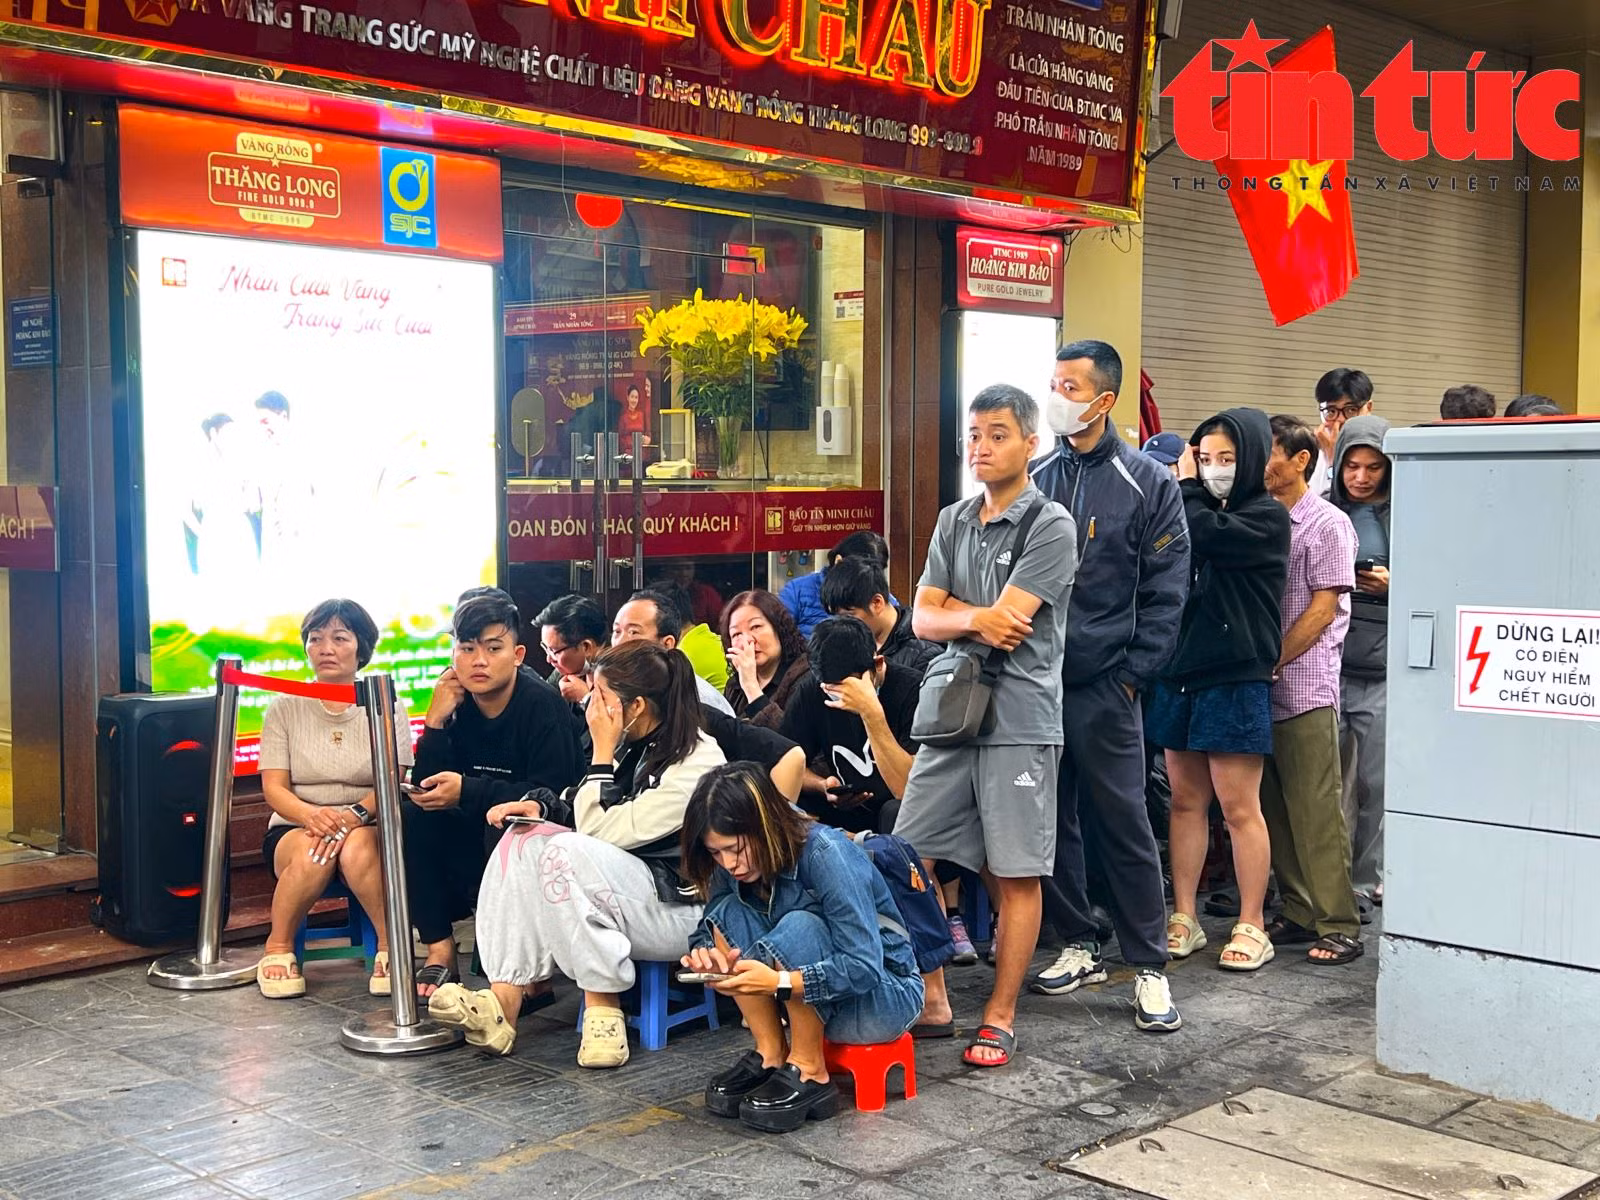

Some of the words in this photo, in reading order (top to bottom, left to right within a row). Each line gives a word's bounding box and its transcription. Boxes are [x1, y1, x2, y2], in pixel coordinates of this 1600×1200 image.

[1045, 16, 1085, 45] NHÂN
[1087, 25, 1124, 54] TÔNG
[300, 4, 384, 46] TRANG
[388, 19, 436, 56] SỨC
[439, 31, 476, 62] MỸ
[480, 41, 541, 82] NGHỆ
[545, 52, 600, 87] CHẤT
[602, 63, 646, 99] LIỆU
[808, 103, 863, 136] THĂNG
[866, 115, 908, 144] LONG
[1077, 98, 1108, 121] BTMC
[1055, 123, 1086, 146] NHÂN
[1087, 128, 1119, 152] TÔNG
[1056, 153, 1082, 172] 1989
[212, 164, 281, 191] THĂNG
[285, 175, 337, 199] LONG
[1007, 261, 1027, 279] KIM
[977, 283, 995, 293] PURE
[995, 285, 1014, 295] GOLD
[1015, 287, 1044, 297] JEWELRY
[826, 508, 850, 519] MINH
[508, 519, 545, 538] OAN
[550, 515, 587, 536] ĐÓN
[643, 513, 675, 536] QUÝ
[680, 512, 731, 534] KHÁCH
[1497, 620, 1554, 642] DỪNG
[1515, 647, 1538, 662] CÓ
[1542, 648, 1579, 666] ĐIỆN
[1503, 669, 1547, 683] NGUY
[1499, 686, 1541, 704] CHẾT
[1545, 692, 1596, 708] NGƯỜI
